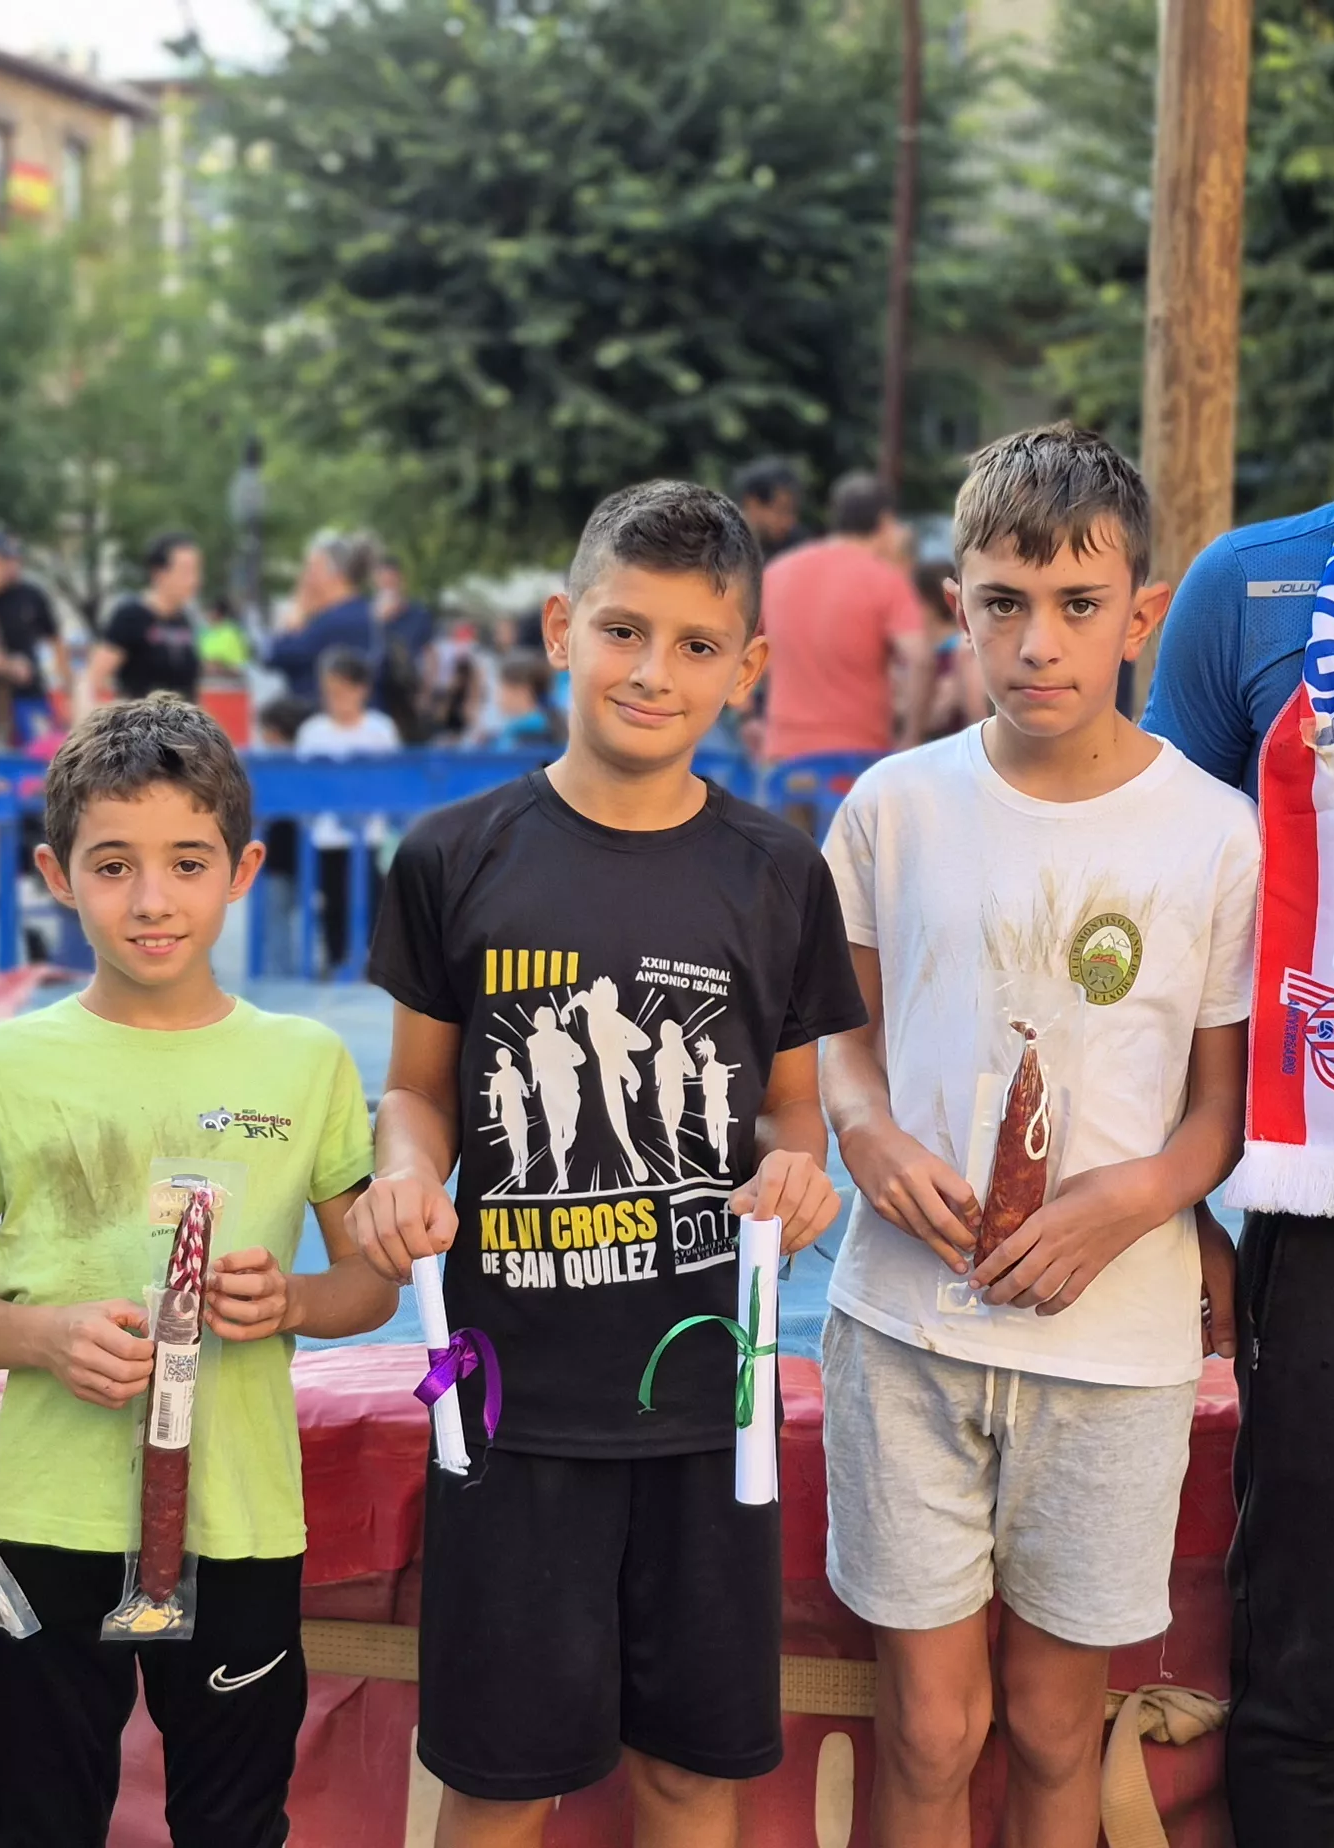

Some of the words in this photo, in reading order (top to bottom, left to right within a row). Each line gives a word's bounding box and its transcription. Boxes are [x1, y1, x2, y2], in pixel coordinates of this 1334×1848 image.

[635, 970, 690, 989] ANTONIO
[692, 979, 729, 997] ISÁBAL
[640, 956, 671, 971] XXIII
[673, 960, 731, 983] MEMORIAL
[479, 1207, 543, 1251] XLVI
[550, 1198, 658, 1250] CROSS
[482, 1252, 501, 1275] DE
[505, 1250, 557, 1289] SAN
[563, 1239, 659, 1290] QUÍLEZ
